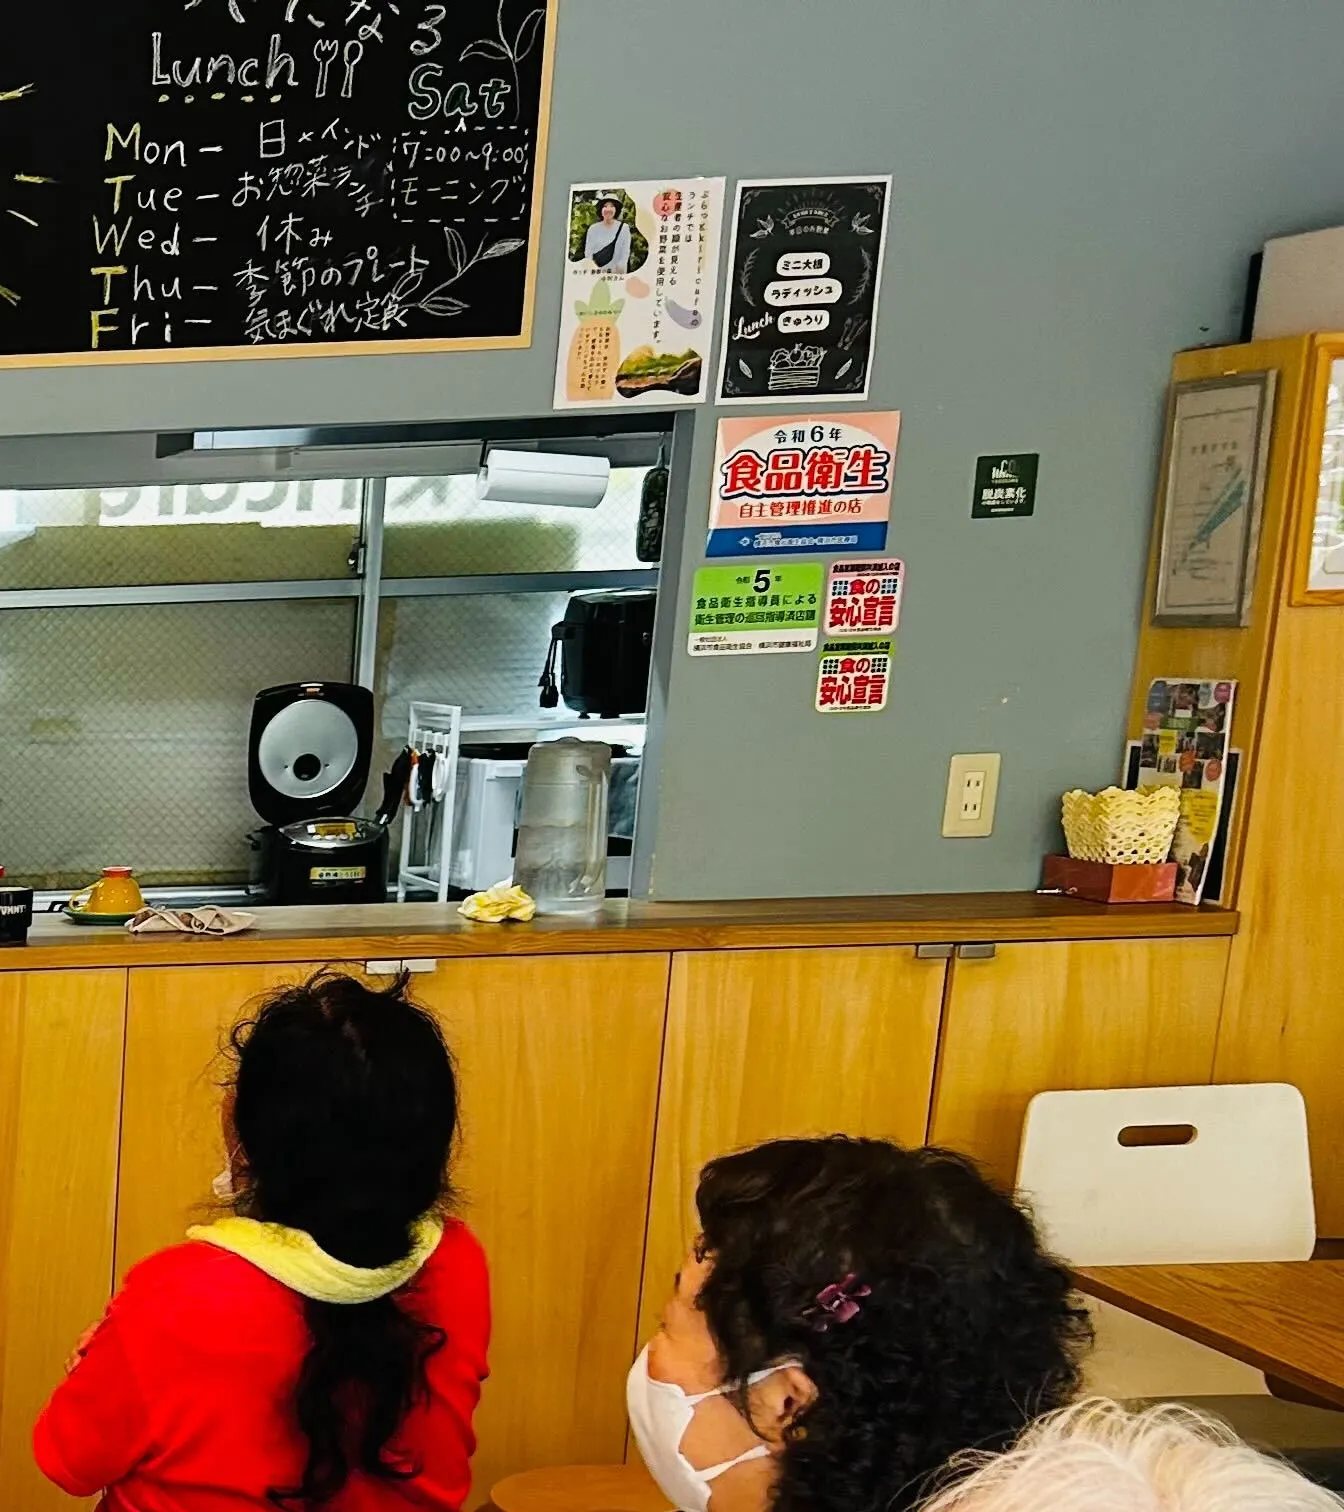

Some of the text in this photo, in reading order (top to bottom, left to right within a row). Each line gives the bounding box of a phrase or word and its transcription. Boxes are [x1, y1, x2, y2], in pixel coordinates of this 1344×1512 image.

[151, 31, 299, 87] Lunch
[408, 62, 512, 120] Sat
[401, 176, 524, 206] モーニング
[255, 212, 333, 255] 休み
[232, 246, 430, 306] 季節のプレート
[781, 258, 823, 271] ミニ大根
[771, 285, 833, 300] ラディッシュ
[243, 290, 411, 346] 気まぐれ定食
[732, 310, 776, 341] Lunch
[782, 314, 823, 327] きゅうり
[774, 425, 843, 444] 令和6年
[721, 447, 888, 496] 食品衛生
[739, 499, 862, 519] 自主管理推進の店
[849, 578, 881, 596] 食の
[829, 596, 897, 628] 安心宣言
[839, 657, 871, 675] 食の
[819, 674, 886, 706] 安心宣言
